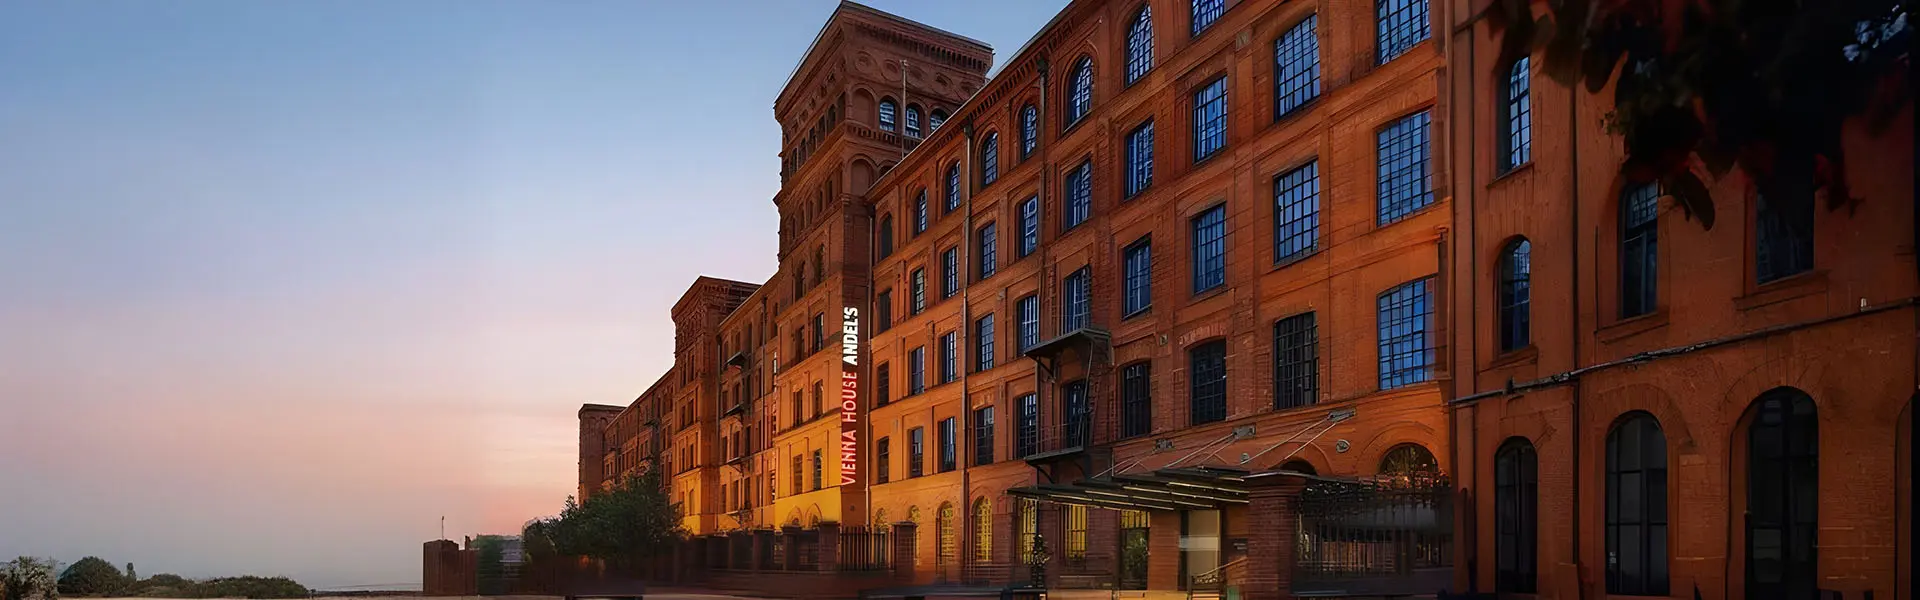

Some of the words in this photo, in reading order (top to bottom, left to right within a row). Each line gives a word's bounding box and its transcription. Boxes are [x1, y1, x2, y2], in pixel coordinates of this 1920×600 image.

[843, 307, 858, 366] ANDEL'S
[842, 371, 857, 423] HOUSE
[841, 429, 857, 486] VIENNA
